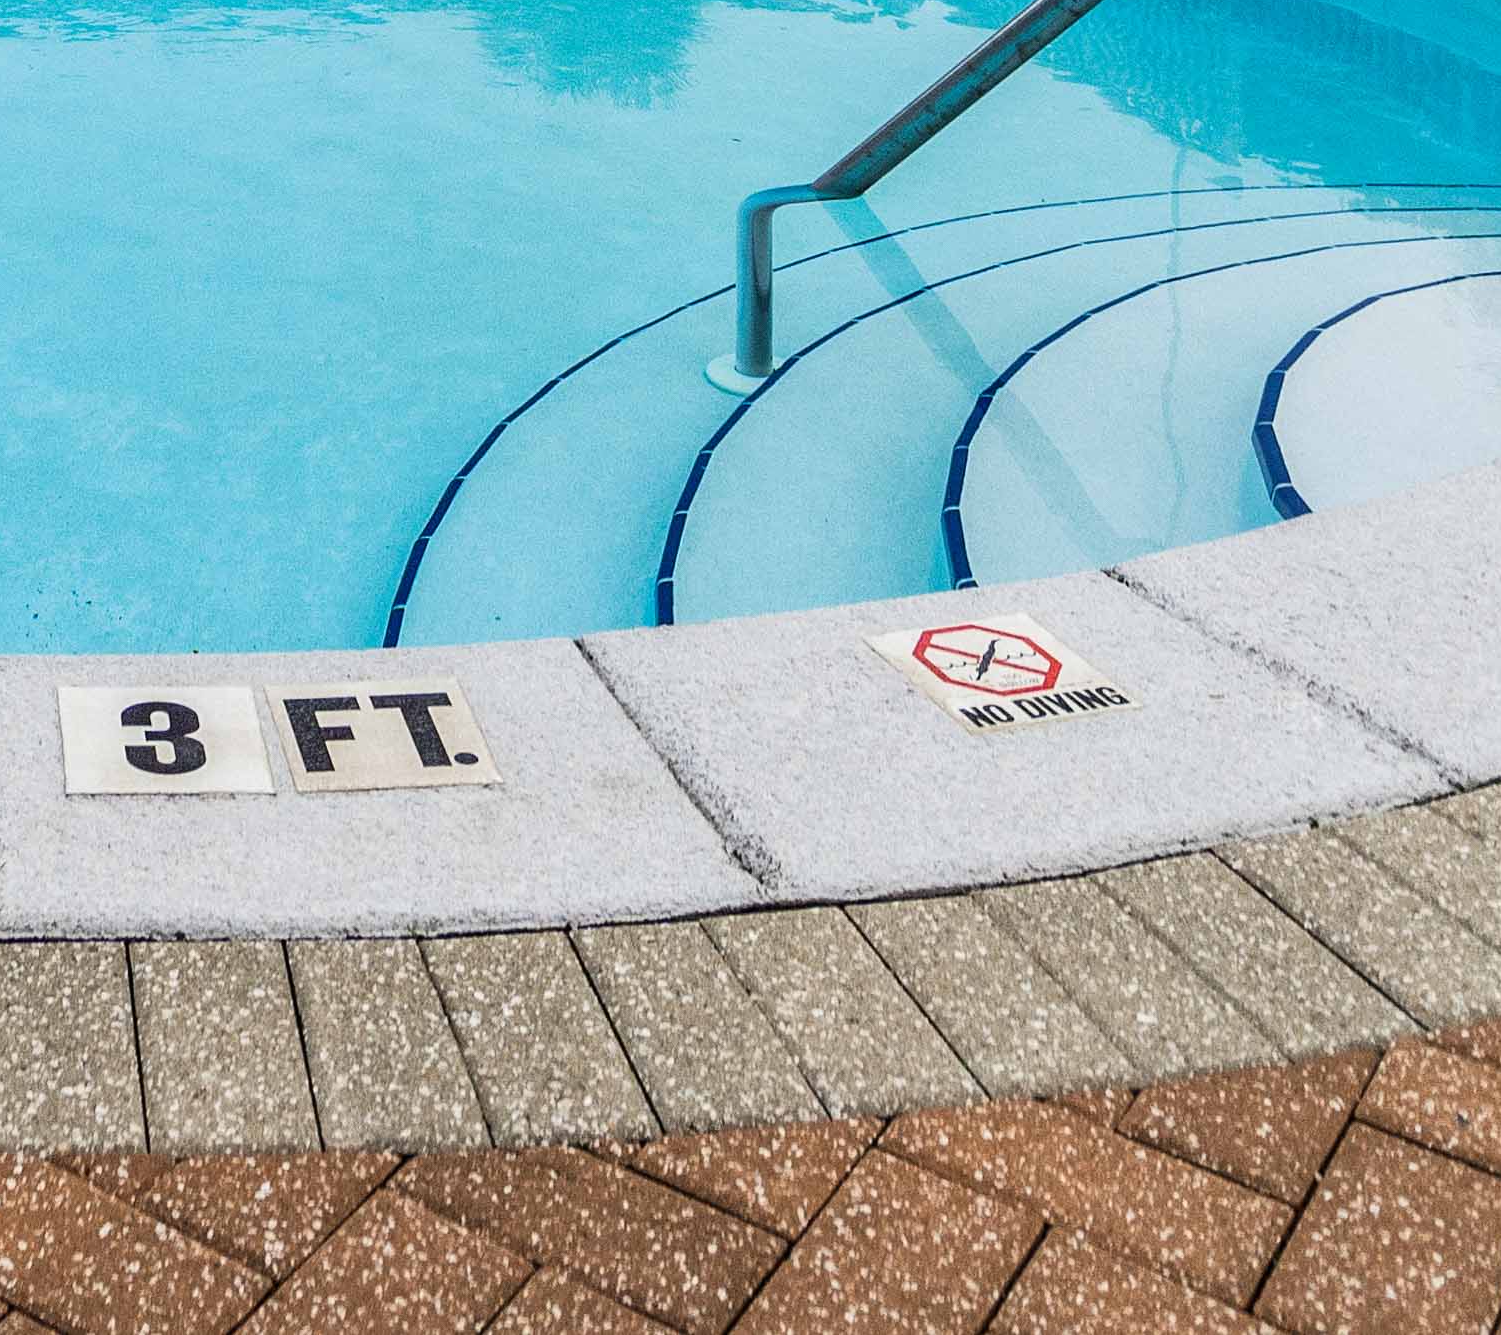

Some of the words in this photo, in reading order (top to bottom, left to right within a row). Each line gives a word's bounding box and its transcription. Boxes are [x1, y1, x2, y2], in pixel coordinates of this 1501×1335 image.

[119, 700, 208, 775] 3
[282, 691, 480, 773] FT.
[958, 703, 1016, 729] NO
[1012, 685, 1130, 720] DIVING
